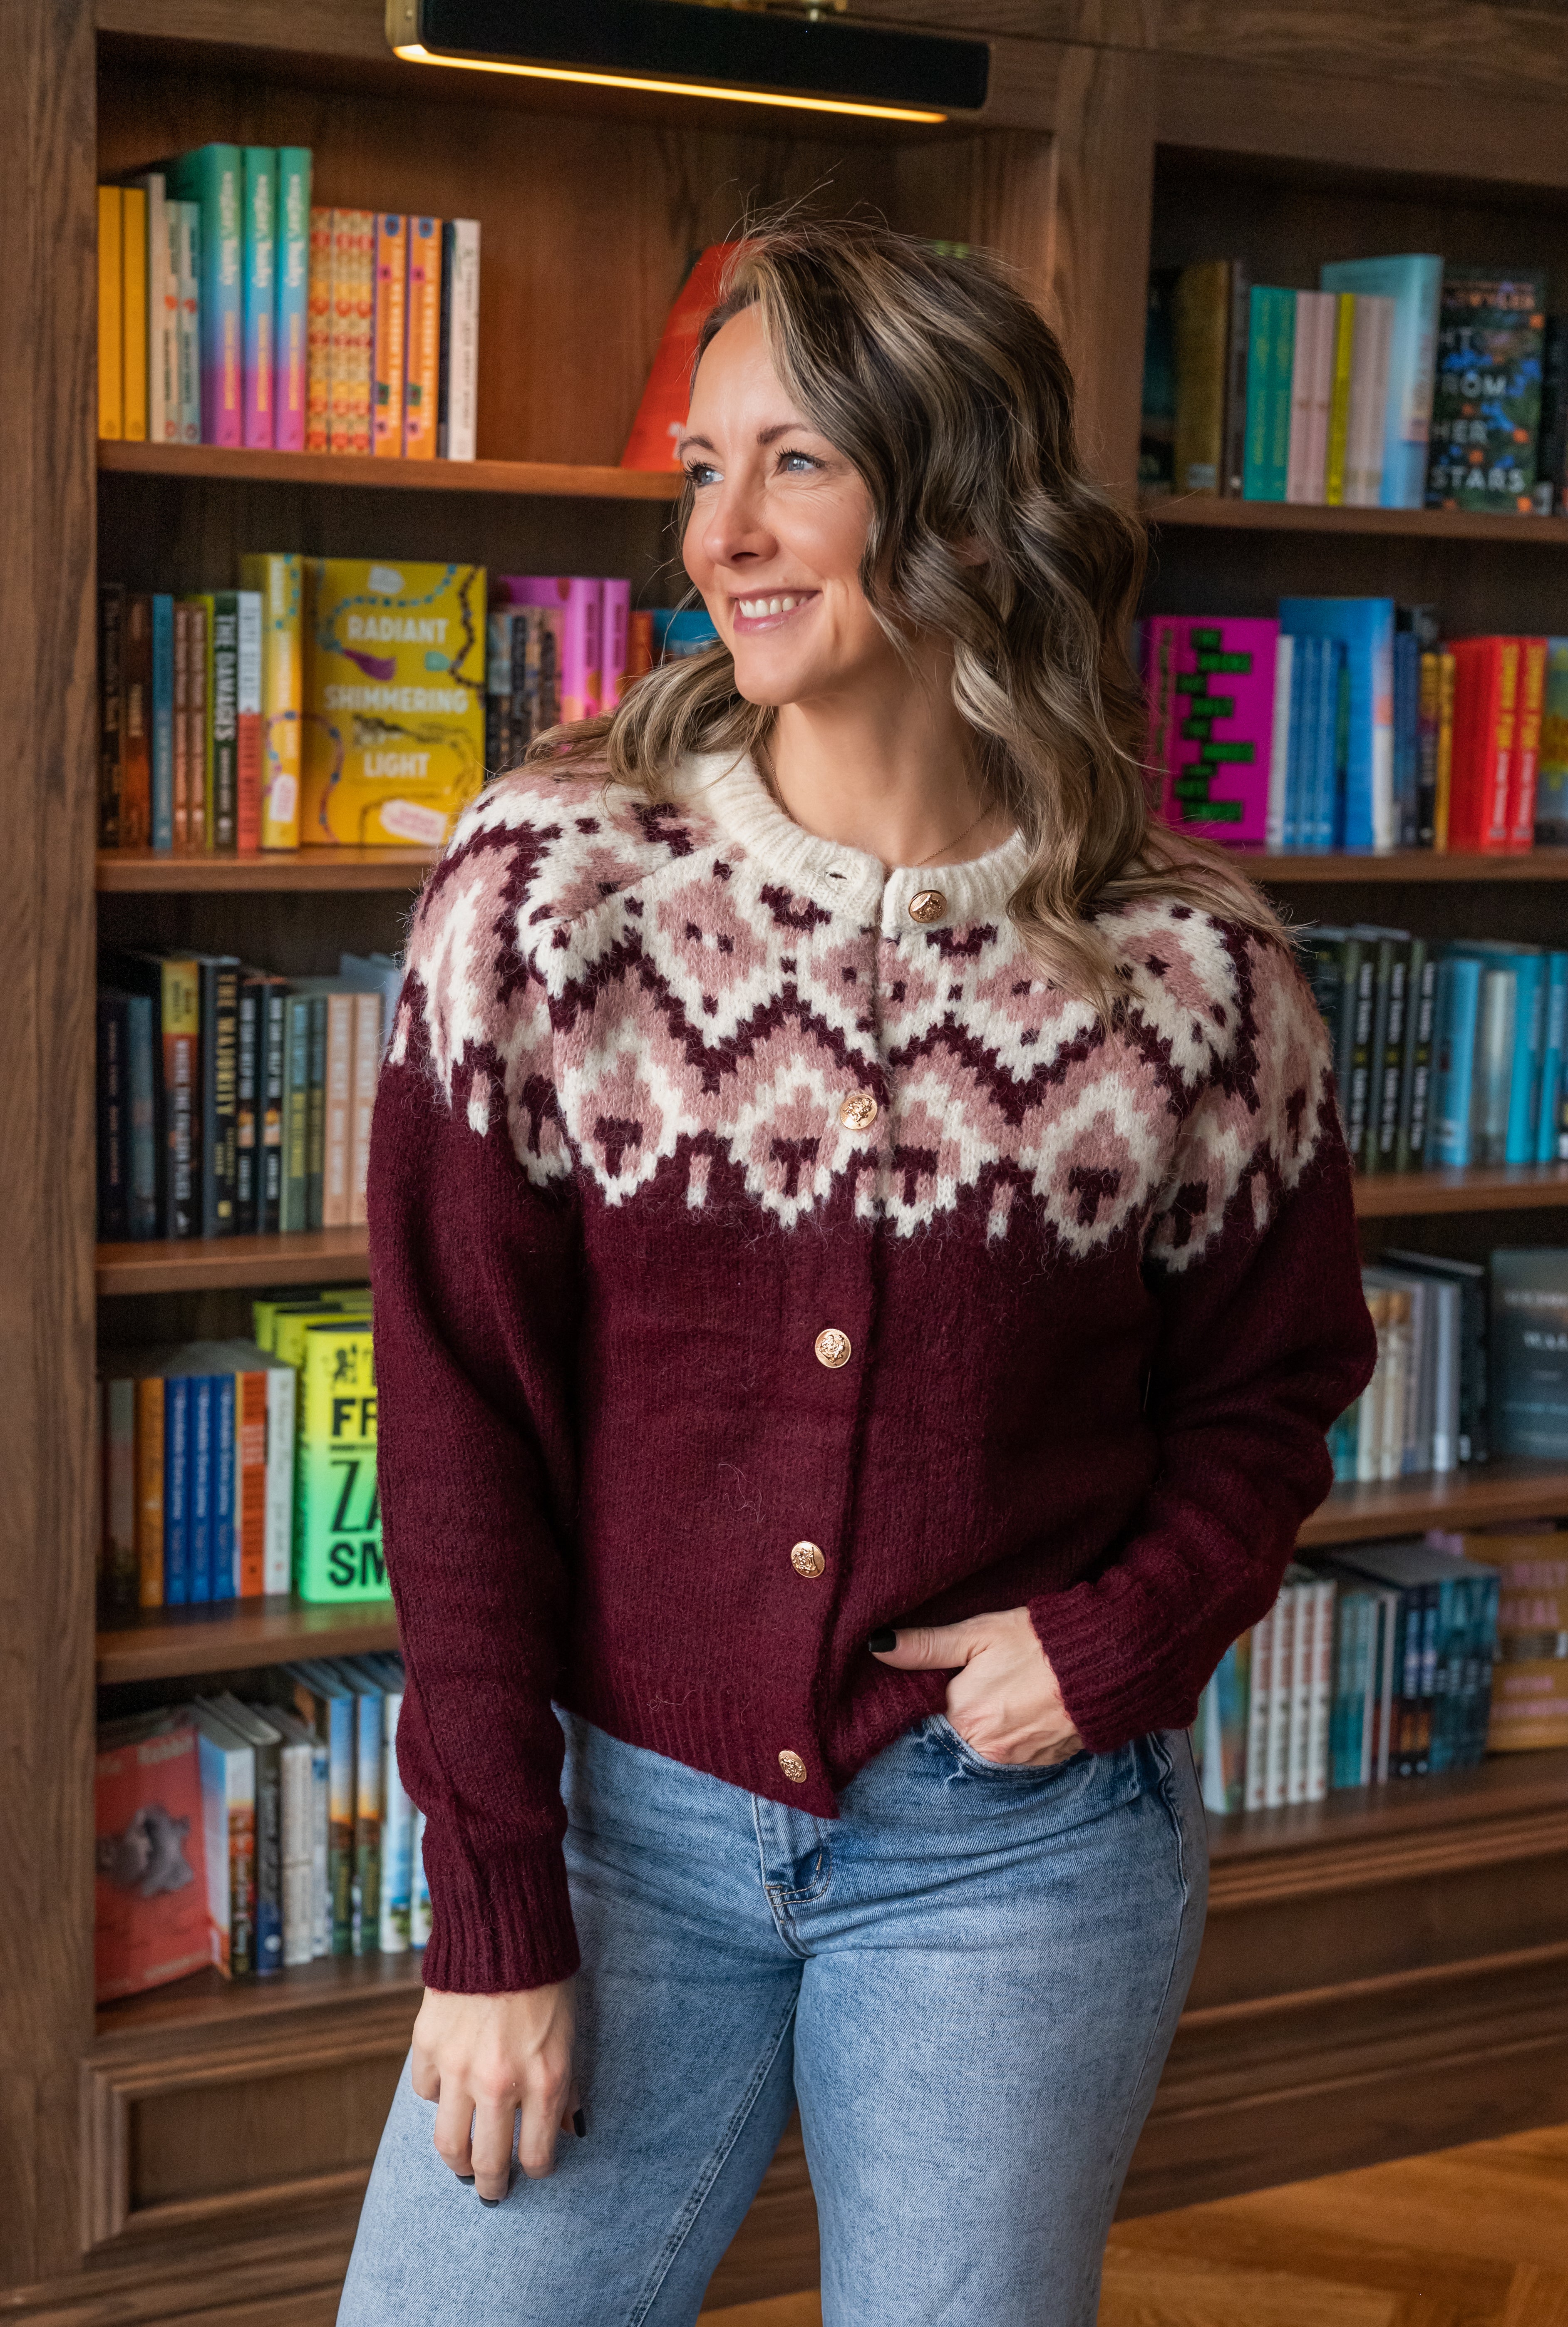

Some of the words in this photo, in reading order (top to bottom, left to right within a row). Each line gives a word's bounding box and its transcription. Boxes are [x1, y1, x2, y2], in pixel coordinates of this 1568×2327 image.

[1429, 465, 1526, 493] STARS
[215, 615, 235, 648] THE
[348, 614, 449, 644] RADIANT
[215, 652, 235, 740] DAMAGES
[324, 683, 469, 714] SHIMMERING
[364, 752, 431, 778] LIGHT
[216, 975, 236, 1007] THE
[175, 1040, 190, 1084] WHERE
[215, 1018, 236, 1116] MAJORITY
[175, 1087, 190, 1110] THE
